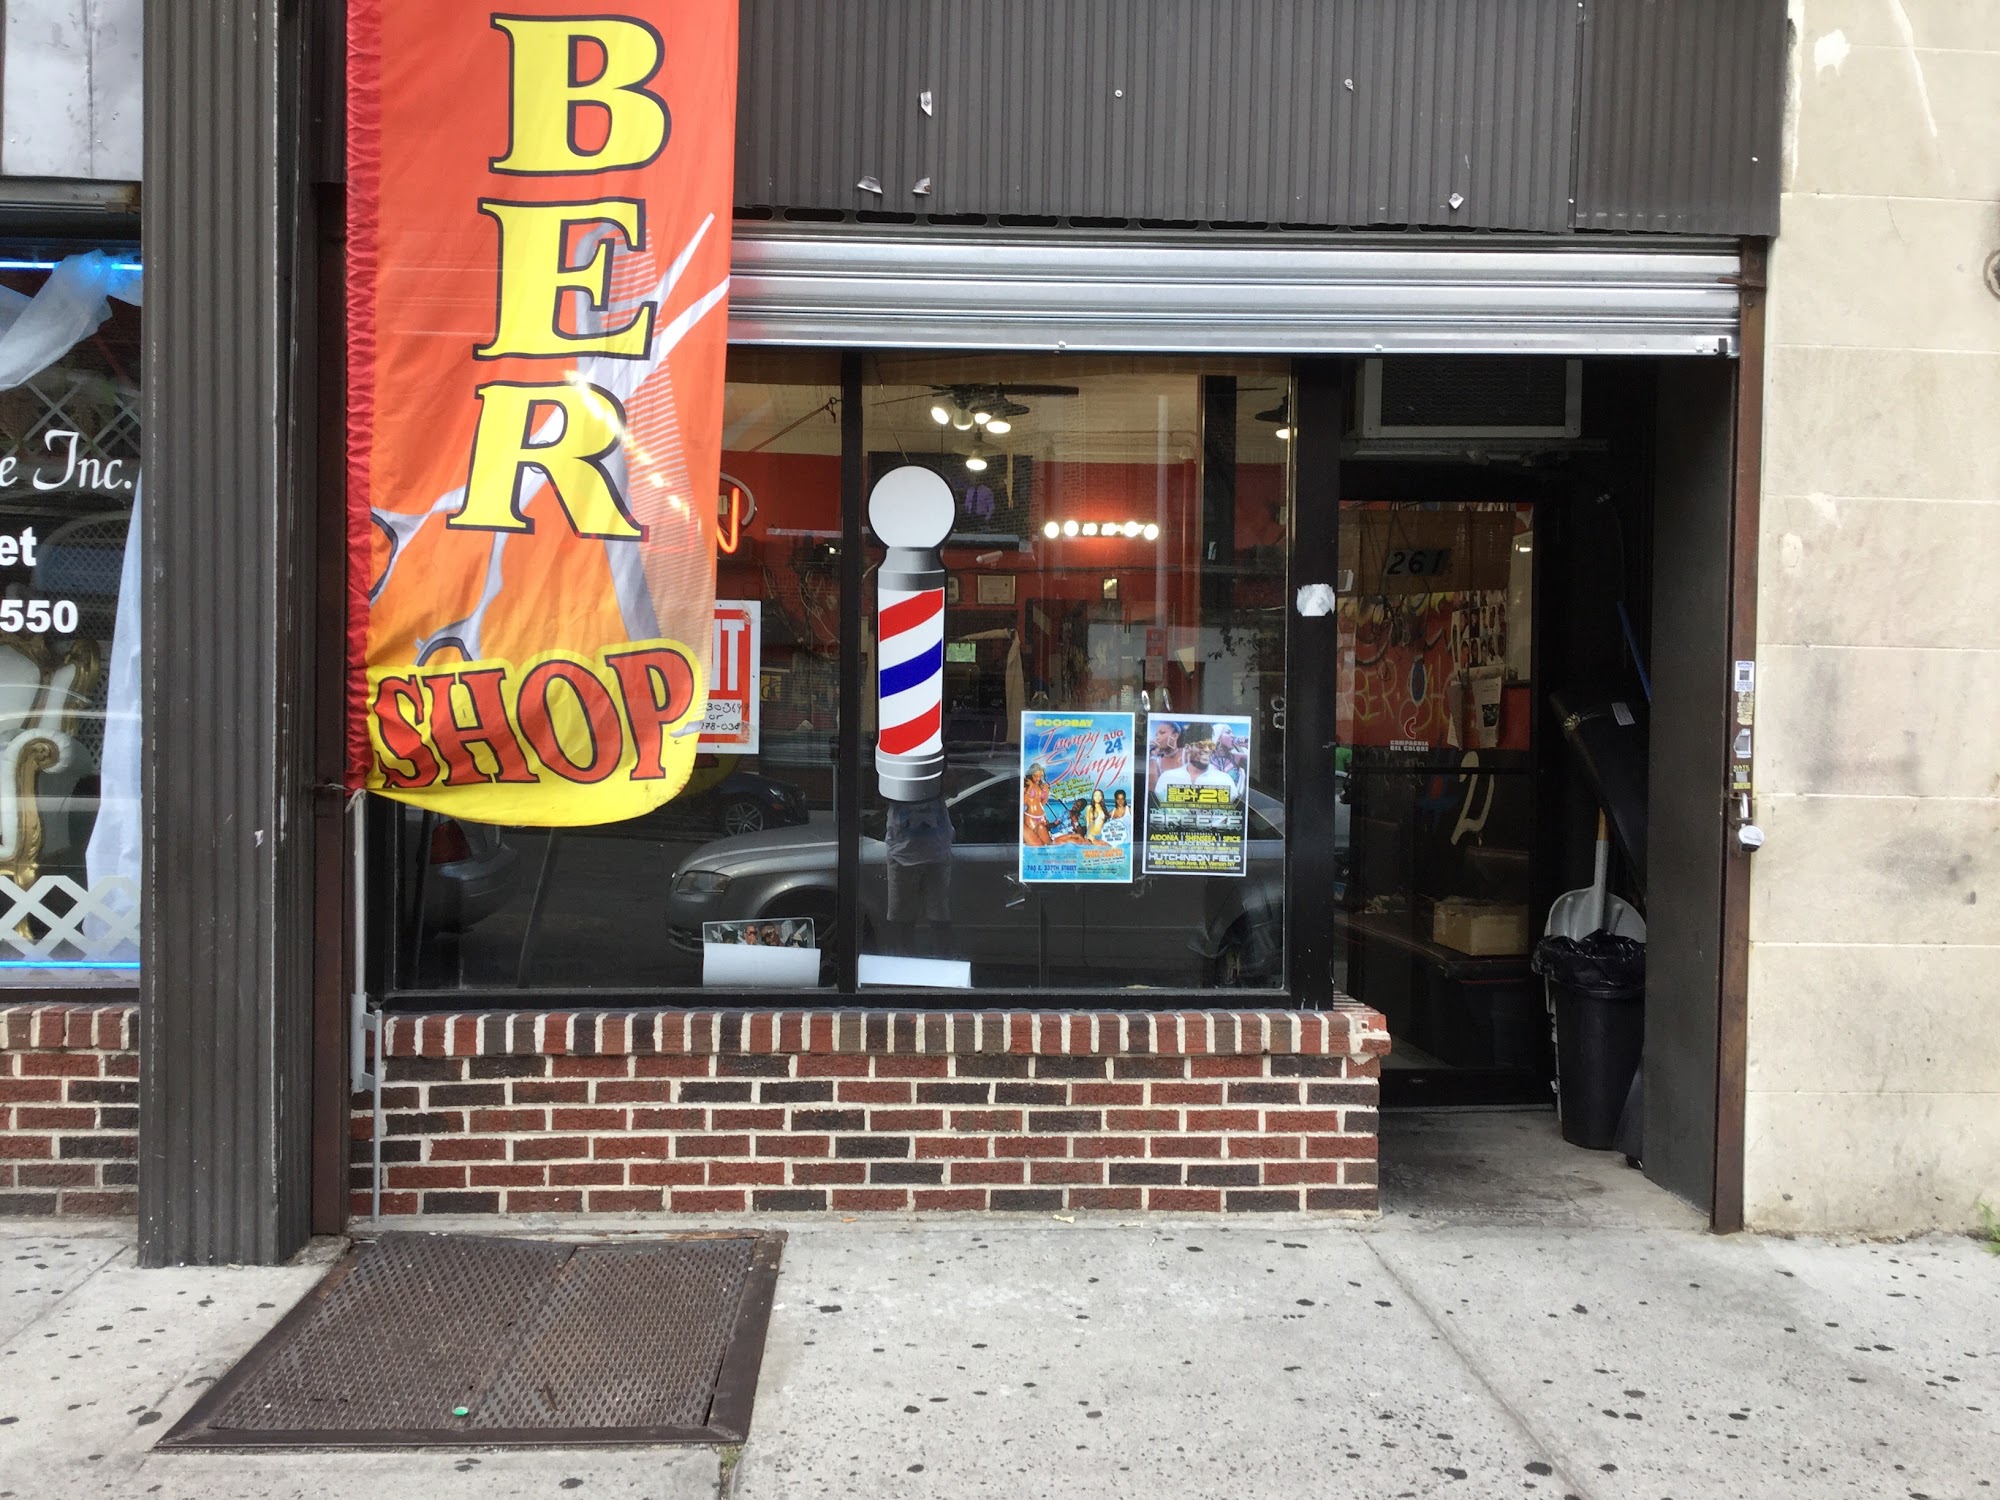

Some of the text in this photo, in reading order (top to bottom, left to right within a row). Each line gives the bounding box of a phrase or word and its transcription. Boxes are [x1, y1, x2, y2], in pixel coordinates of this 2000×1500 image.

[33, 430, 133, 490] Inc.
[1387, 551, 1442, 576] 261
[373, 646, 696, 789] SHOP
[1103, 730, 1124, 742] AUG
[1104, 739, 1123, 754] 24
[1199, 789, 1217, 803] 2
[1149, 814, 1243, 828] BREEZE
[1222, 835, 1241, 843] SPICE
[1148, 853, 1241, 863] HUTCHINSON FIELD
